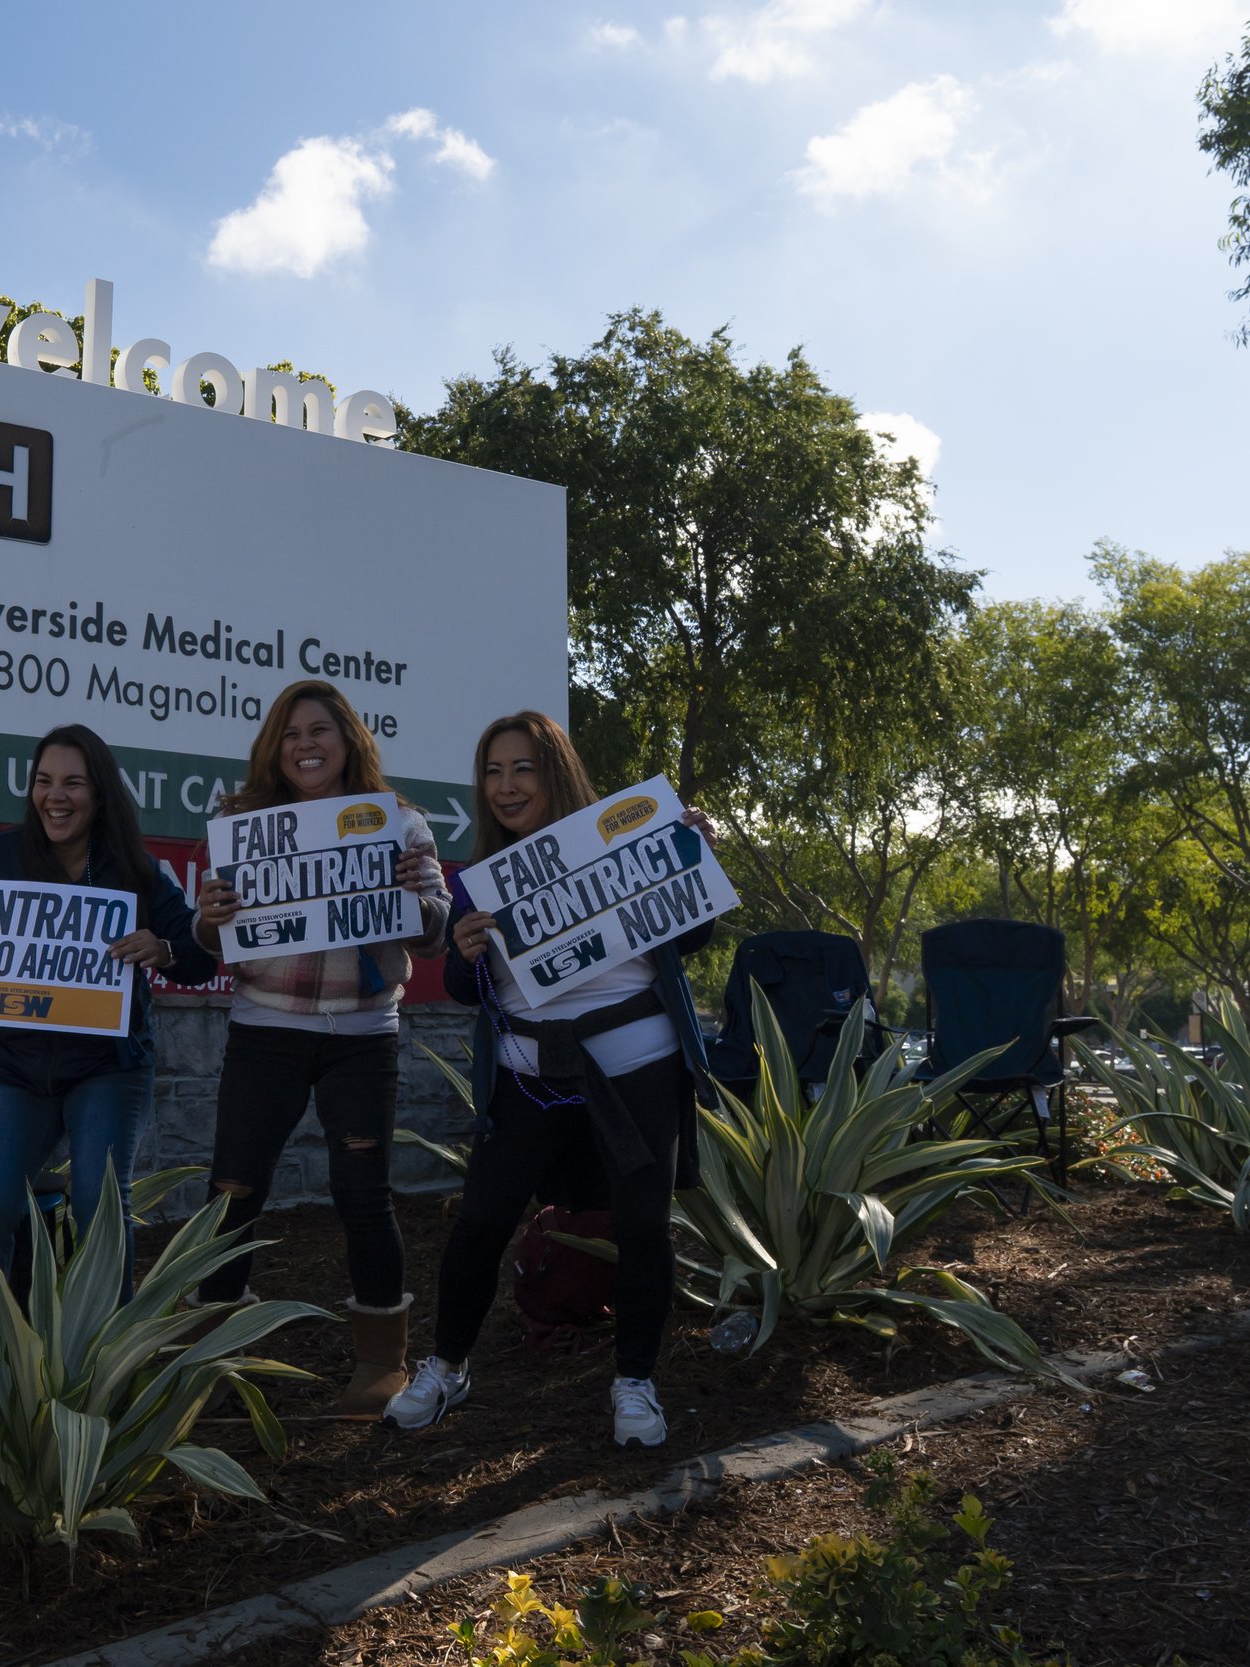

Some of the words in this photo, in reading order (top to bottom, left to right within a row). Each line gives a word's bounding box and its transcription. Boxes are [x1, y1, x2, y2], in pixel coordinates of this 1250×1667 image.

[143, 612, 284, 669] Medical
[299, 638, 407, 686] Center
[86, 663, 261, 721] Magnolia
[7, 757, 168, 809] UNT
[232, 811, 299, 863] FAIR
[343, 819, 355, 829] FOR
[357, 816, 384, 827] WORKERS
[605, 820, 621, 834] FOR
[619, 804, 654, 826] WORKERS
[235, 843, 394, 908] CONTRACT
[488, 834, 569, 905] FAIR
[512, 825, 684, 946] CONTRACT
[235, 916, 307, 949] USW
[236, 917, 257, 925] UNITED
[258, 910, 303, 922] STEELWORKERS
[327, 890, 402, 943] NOW!
[616, 868, 714, 951] NOW!
[17, 943, 124, 986] AHORA!
[529, 951, 551, 966] UNITED
[551, 928, 596, 954] STEELWORKERS
[530, 932, 607, 987] USW
